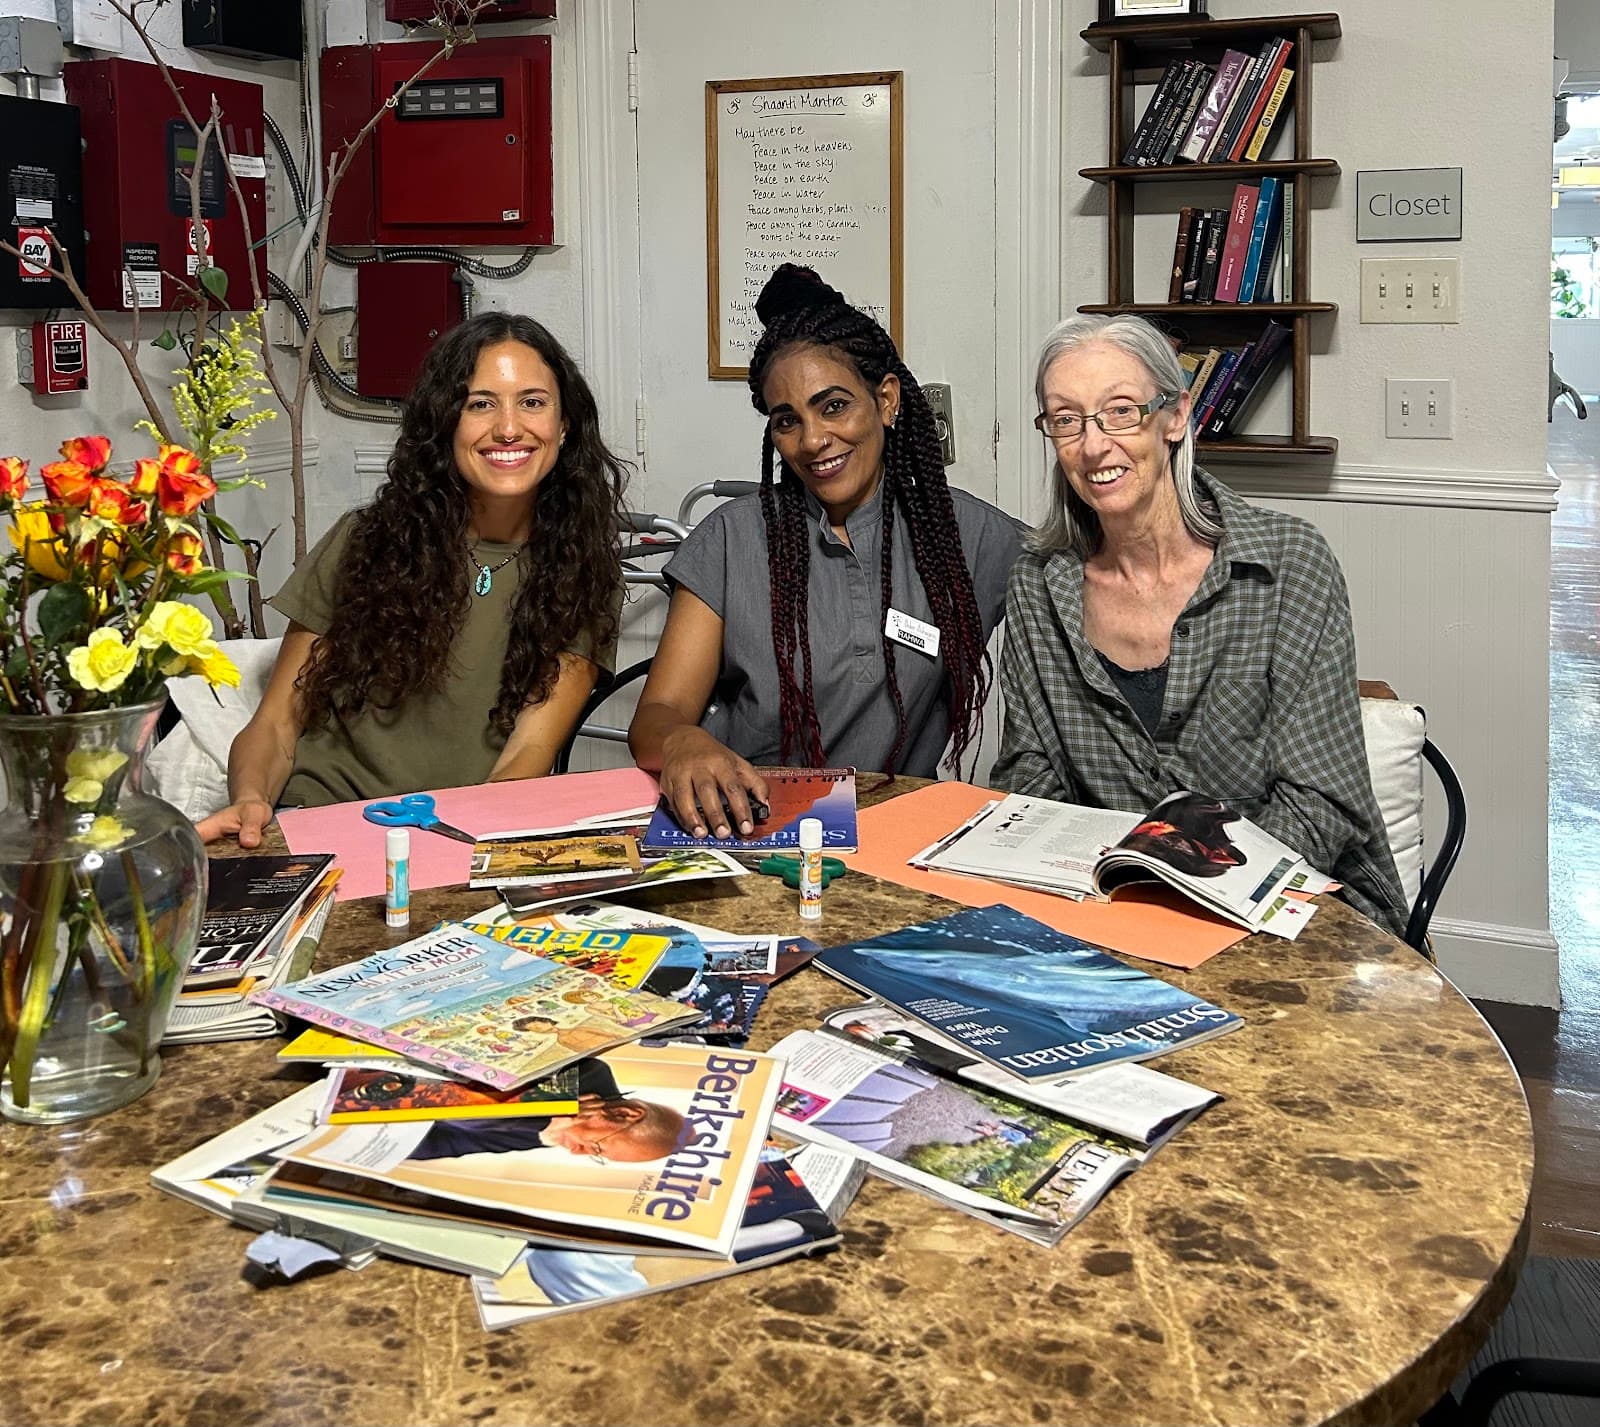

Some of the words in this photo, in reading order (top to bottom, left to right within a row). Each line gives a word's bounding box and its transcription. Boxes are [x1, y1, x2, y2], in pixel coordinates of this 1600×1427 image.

[1184, 62, 1203, 90] Sound
[751, 94, 797, 114] Shaanti
[800, 92, 848, 110] Mantra
[735, 127, 755, 143] May
[758, 123, 786, 137] there
[790, 121, 806, 135] be
[752, 143, 778, 158] Peace
[781, 146, 791, 155] in
[794, 144, 810, 153] the
[814, 140, 853, 152] heavens
[753, 161, 777, 173] Peace
[782, 161, 792, 170] in
[794, 159, 811, 168] the
[815, 158, 834, 172] sky
[753, 174, 778, 185] Peace
[784, 175, 794, 184] on
[799, 173, 830, 184] earth
[752, 189, 776, 200] Peace
[781, 190, 791, 198] in
[747, 204, 771, 215] Peace
[773, 205, 799, 219] among
[1369, 192, 1451, 216] Closet
[746, 220, 766, 233] Peace
[798, 219, 812, 228] the
[798, 231, 811, 241] the
[23, 243, 46, 256] BAY
[744, 247, 765, 259] Peace
[768, 250, 787, 260] upon
[789, 248, 803, 258] the
[744, 261, 769, 272] Peace
[744, 277, 764, 286] Peace
[50, 324, 82, 340] FIRE
[359, 955, 391, 969] THE
[430, 947, 480, 967] MOM
[297, 970, 364, 998] NEW
[363, 935, 478, 978] YORKER
[946, 1021, 983, 1033] Wars
[958, 1024, 1009, 1040] Dolphin
[969, 1037, 1002, 1046] The
[1000, 1002, 1230, 1069] Smithsonian
[645, 1054, 757, 1222] Berkshire
[627, 1174, 652, 1216] MAGAZINE
